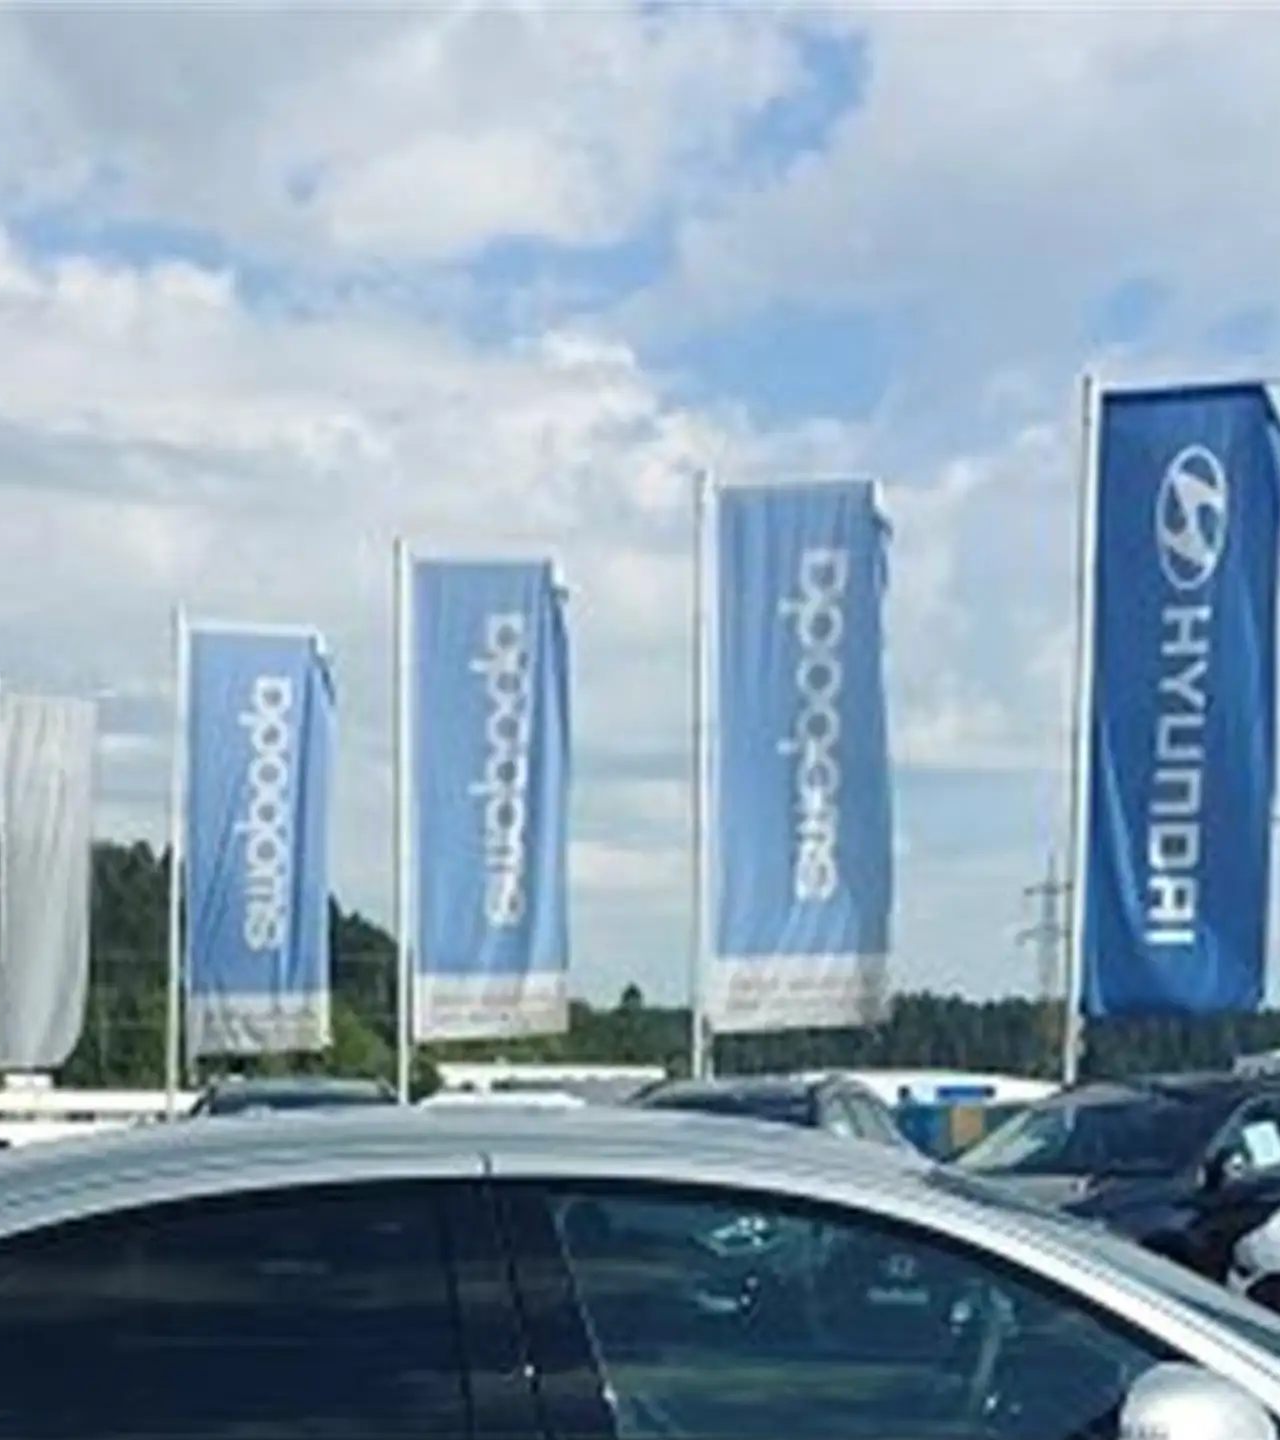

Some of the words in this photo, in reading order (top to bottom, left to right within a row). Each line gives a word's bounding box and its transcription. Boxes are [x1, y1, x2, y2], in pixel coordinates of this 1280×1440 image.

[233, 675, 293, 952] swoboda
[467, 612, 528, 927] swoboda
[776, 546, 848, 902] swoboda
[1144, 604, 1212, 945] HYUNDAI
